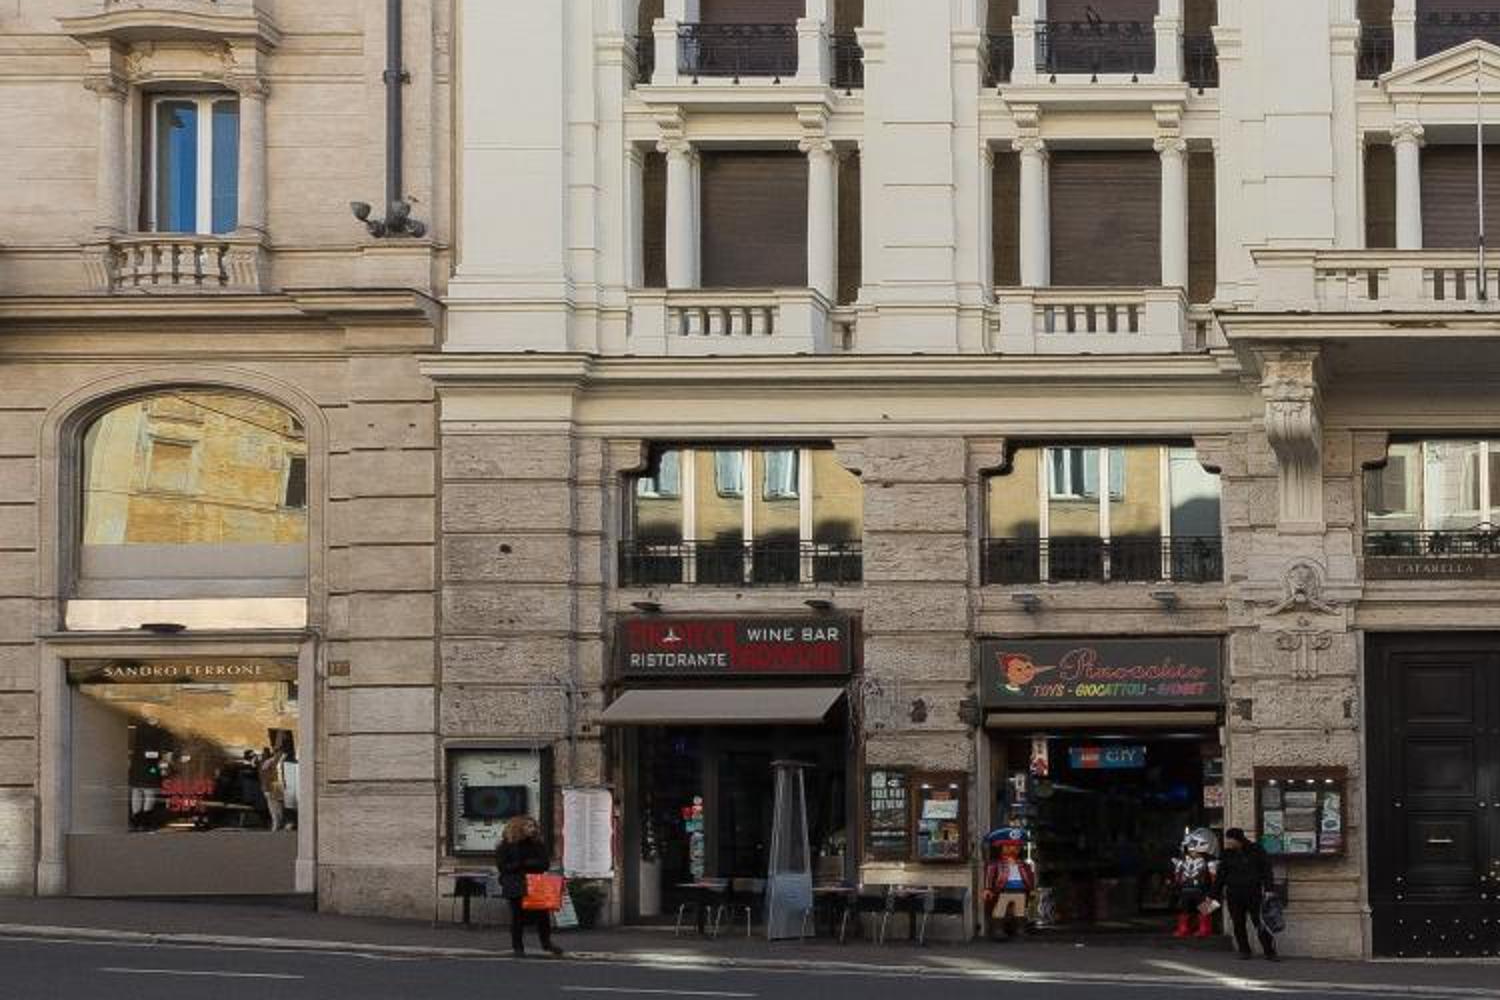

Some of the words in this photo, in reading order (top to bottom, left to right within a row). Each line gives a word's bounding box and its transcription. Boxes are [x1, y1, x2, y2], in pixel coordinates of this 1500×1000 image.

[747, 628, 794, 641] WINE
[801, 627, 840, 641] BAR
[630, 653, 727, 667] RISTORANTE
[103, 663, 178, 677] SANDRO
[1032, 684, 1064, 696] TOYS
